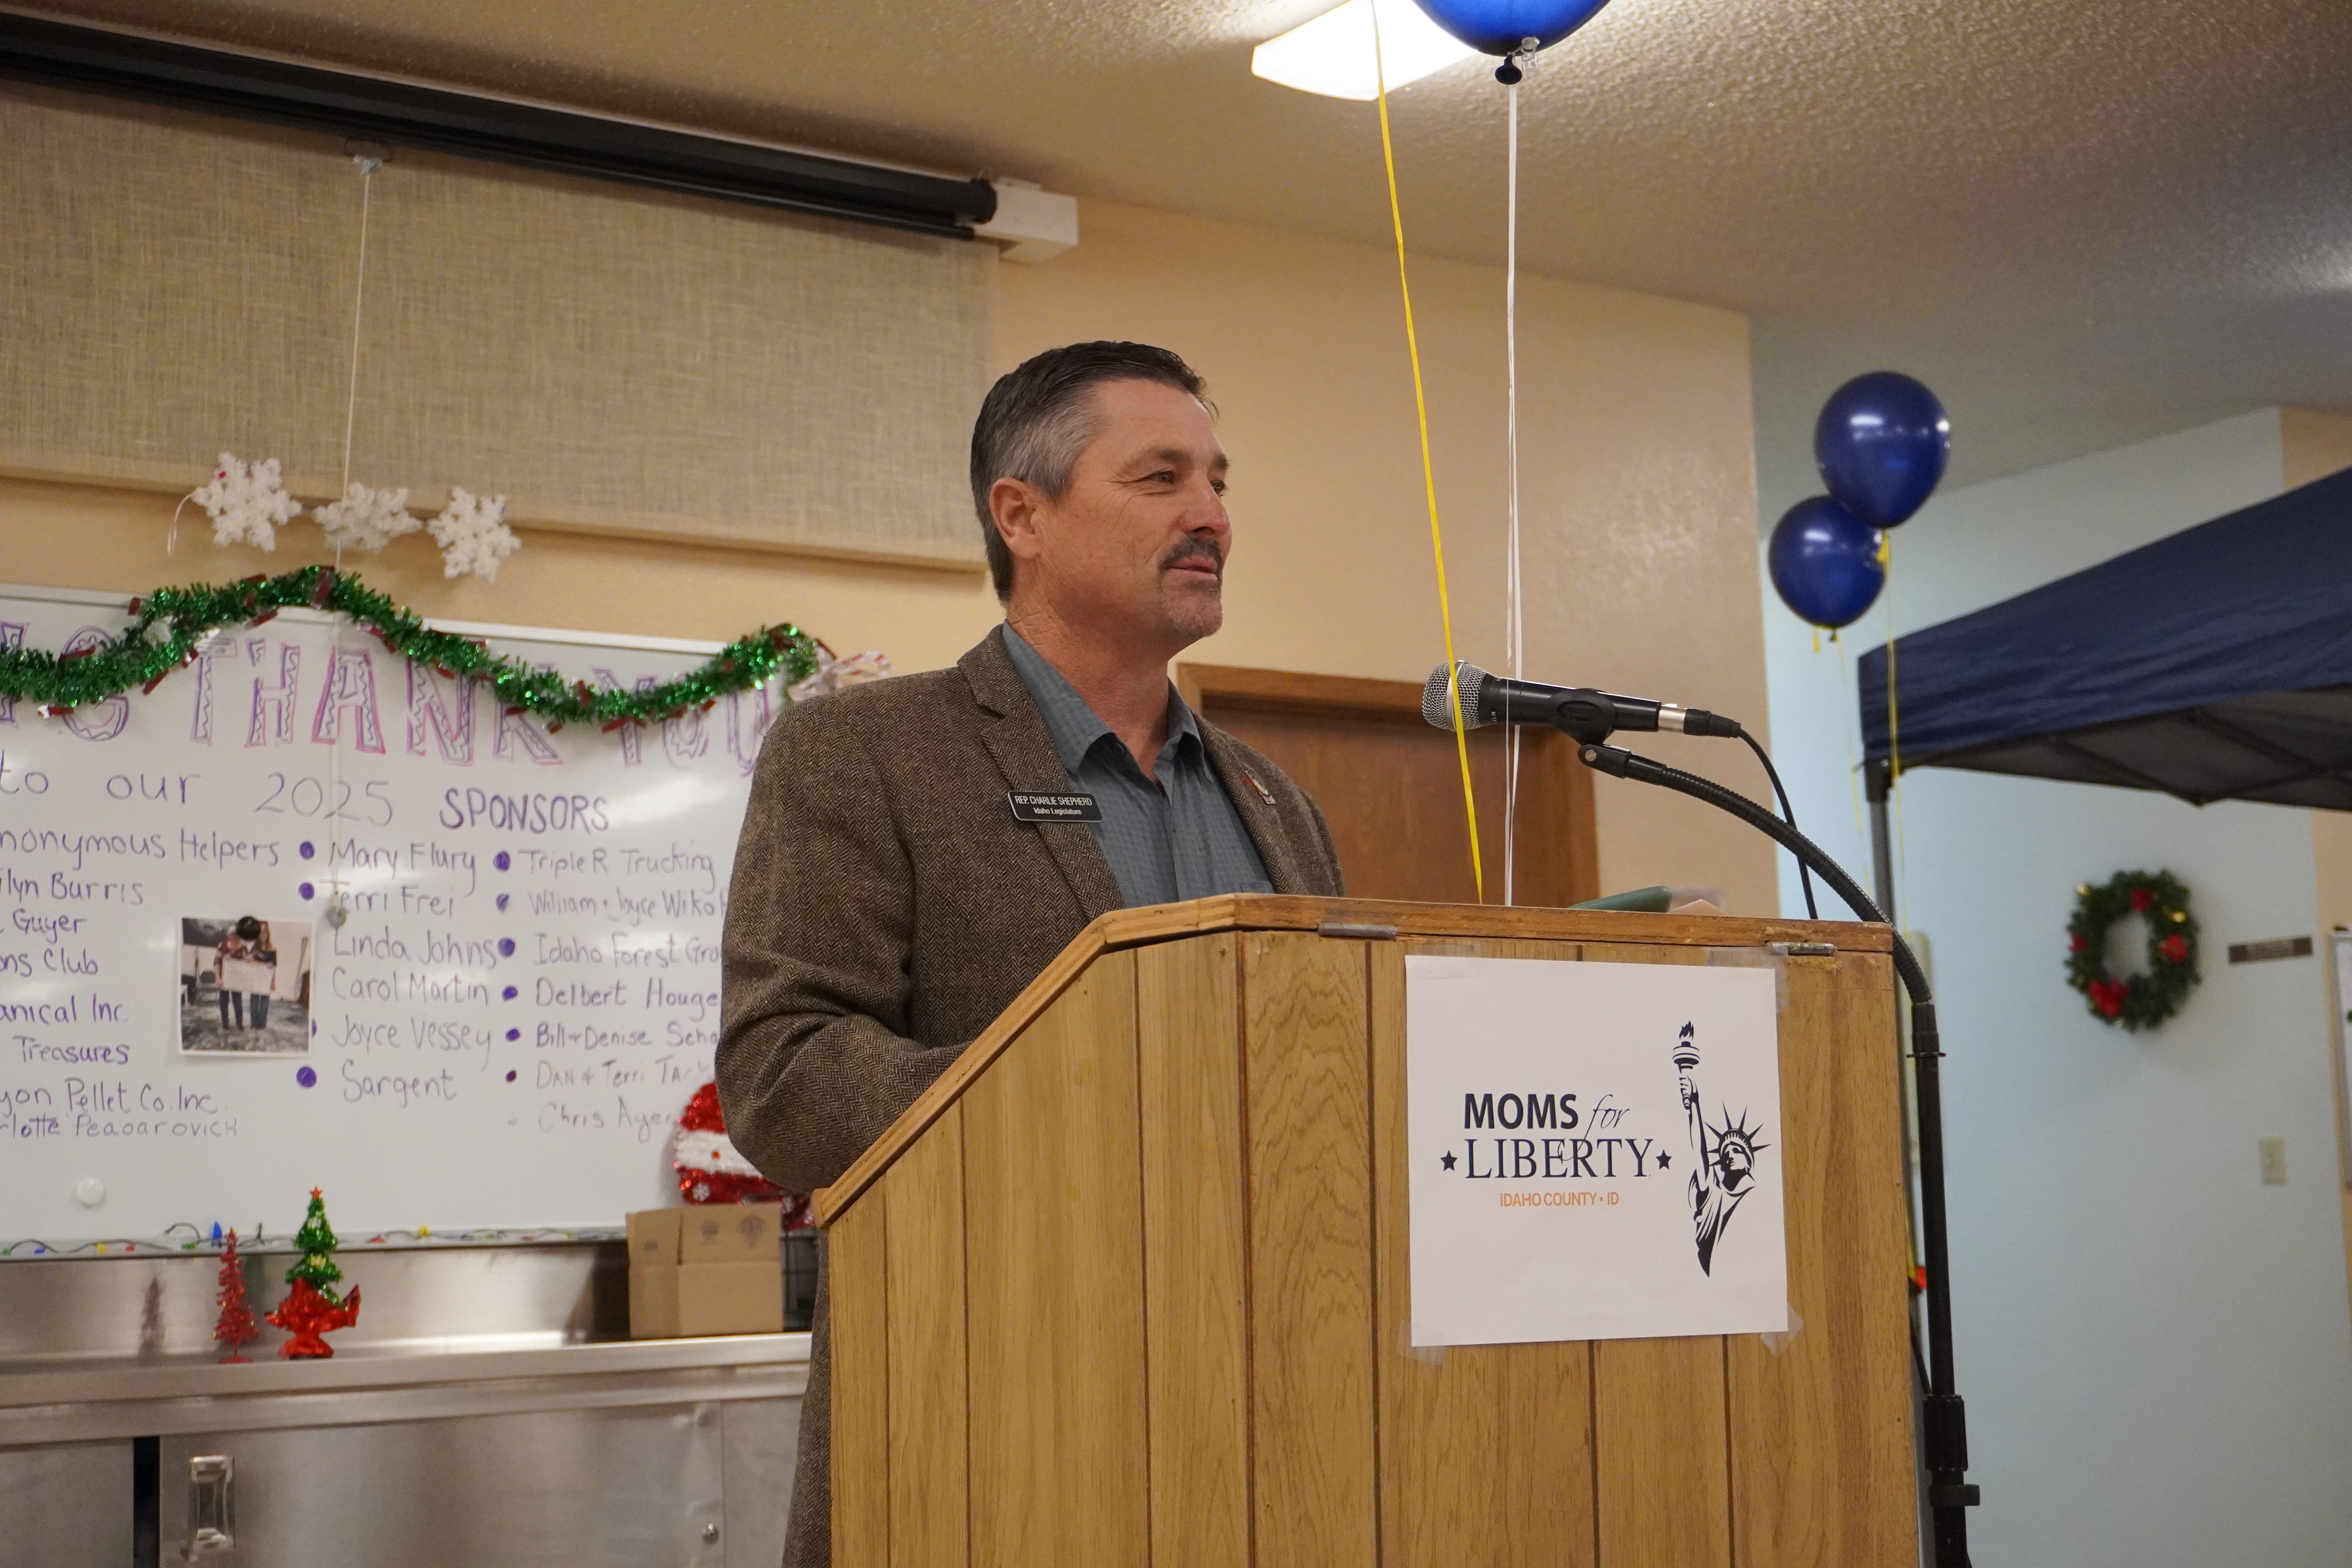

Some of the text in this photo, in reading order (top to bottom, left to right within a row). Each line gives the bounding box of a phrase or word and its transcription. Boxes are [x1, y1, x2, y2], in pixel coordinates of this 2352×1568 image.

[0, 750, 608, 834] to our 2025 SPONSORS
[1014, 795, 1093, 806] REP. CHARLIE SHEPHERD
[180, 828, 279, 870] Helpers
[328, 838, 475, 897] Mary Flury
[517, 842, 716, 895] Triple R Trucking
[51, 871, 143, 905] Burris
[319, 879, 454, 918] Terri Frei
[44, 947, 98, 975] Club
[335, 924, 497, 970] Linda Johns
[534, 932, 602, 966] Idaho
[612, 931, 679, 968] Forest
[332, 966, 489, 1006] Carol Martin
[536, 976, 627, 1007] Delbert
[12, 1034, 130, 1065] Treasures
[332, 1013, 491, 1073] Joyce Vessey
[536, 1022, 565, 1049] Bill
[584, 1025, 652, 1051] Denise
[342, 1059, 457, 1109] Sargent
[537, 1059, 574, 1089] DAN
[65, 1076, 132, 1114] Pellet
[538, 1101, 604, 1133] Chris
[1464, 1093, 1630, 1161] MOMS for
[1464, 1138, 1654, 1178] LIBERTY
[1500, 1192, 1619, 1207] IDAHO COUNTY ID
